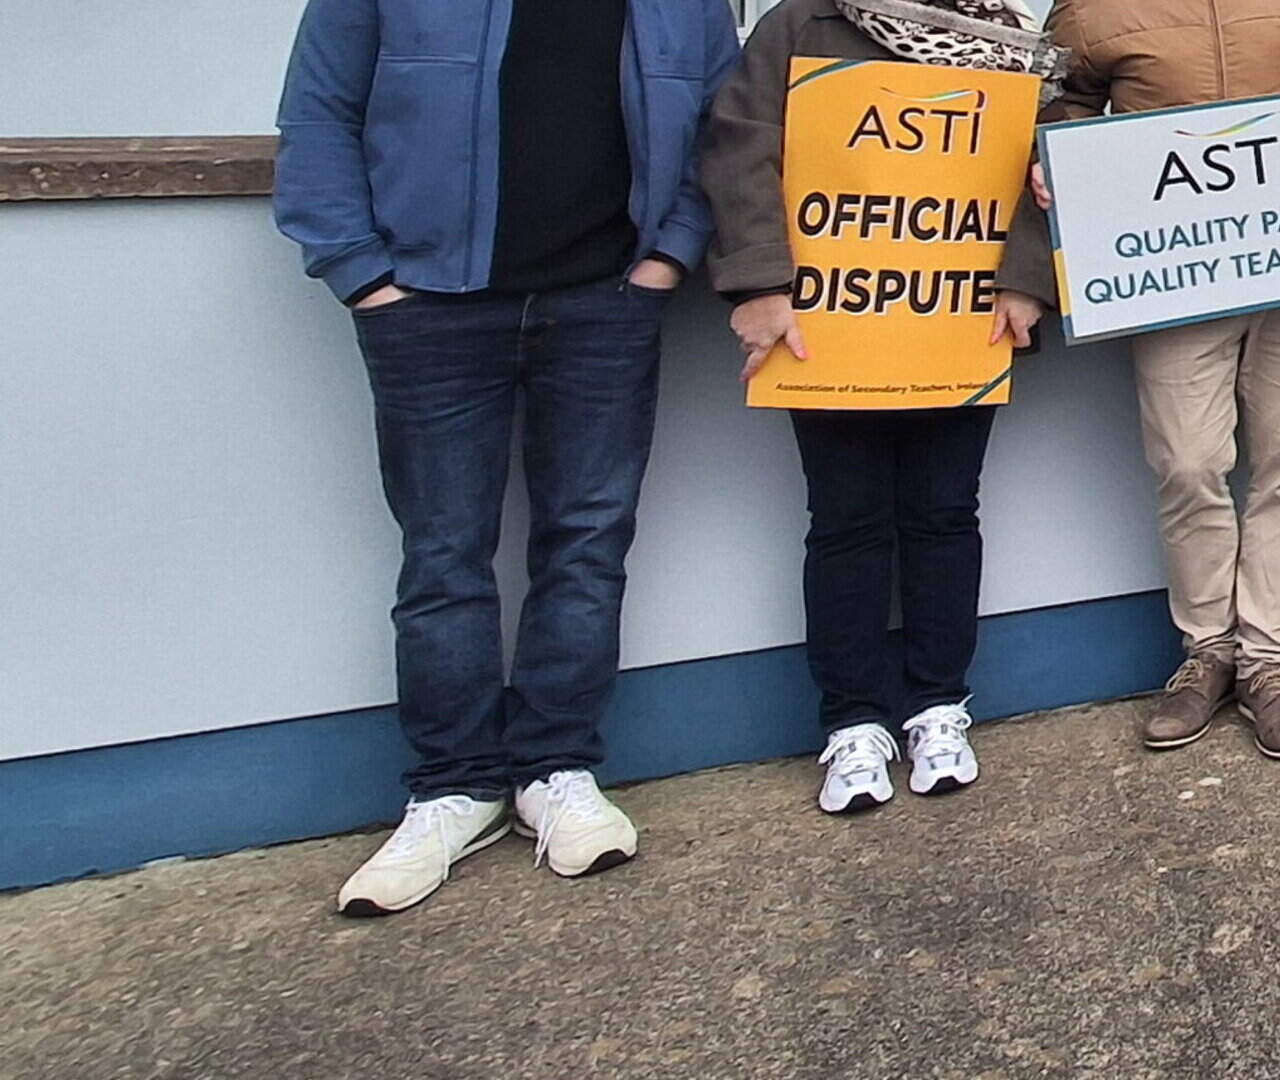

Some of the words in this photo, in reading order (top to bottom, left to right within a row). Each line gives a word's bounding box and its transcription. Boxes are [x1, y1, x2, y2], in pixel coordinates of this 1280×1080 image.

[797, 191, 1008, 243] OFFICIAL
[1114, 214, 1249, 259] QUALITY
[791, 265, 997, 315] DISPUTE
[1084, 258, 1221, 305] QUALITY
